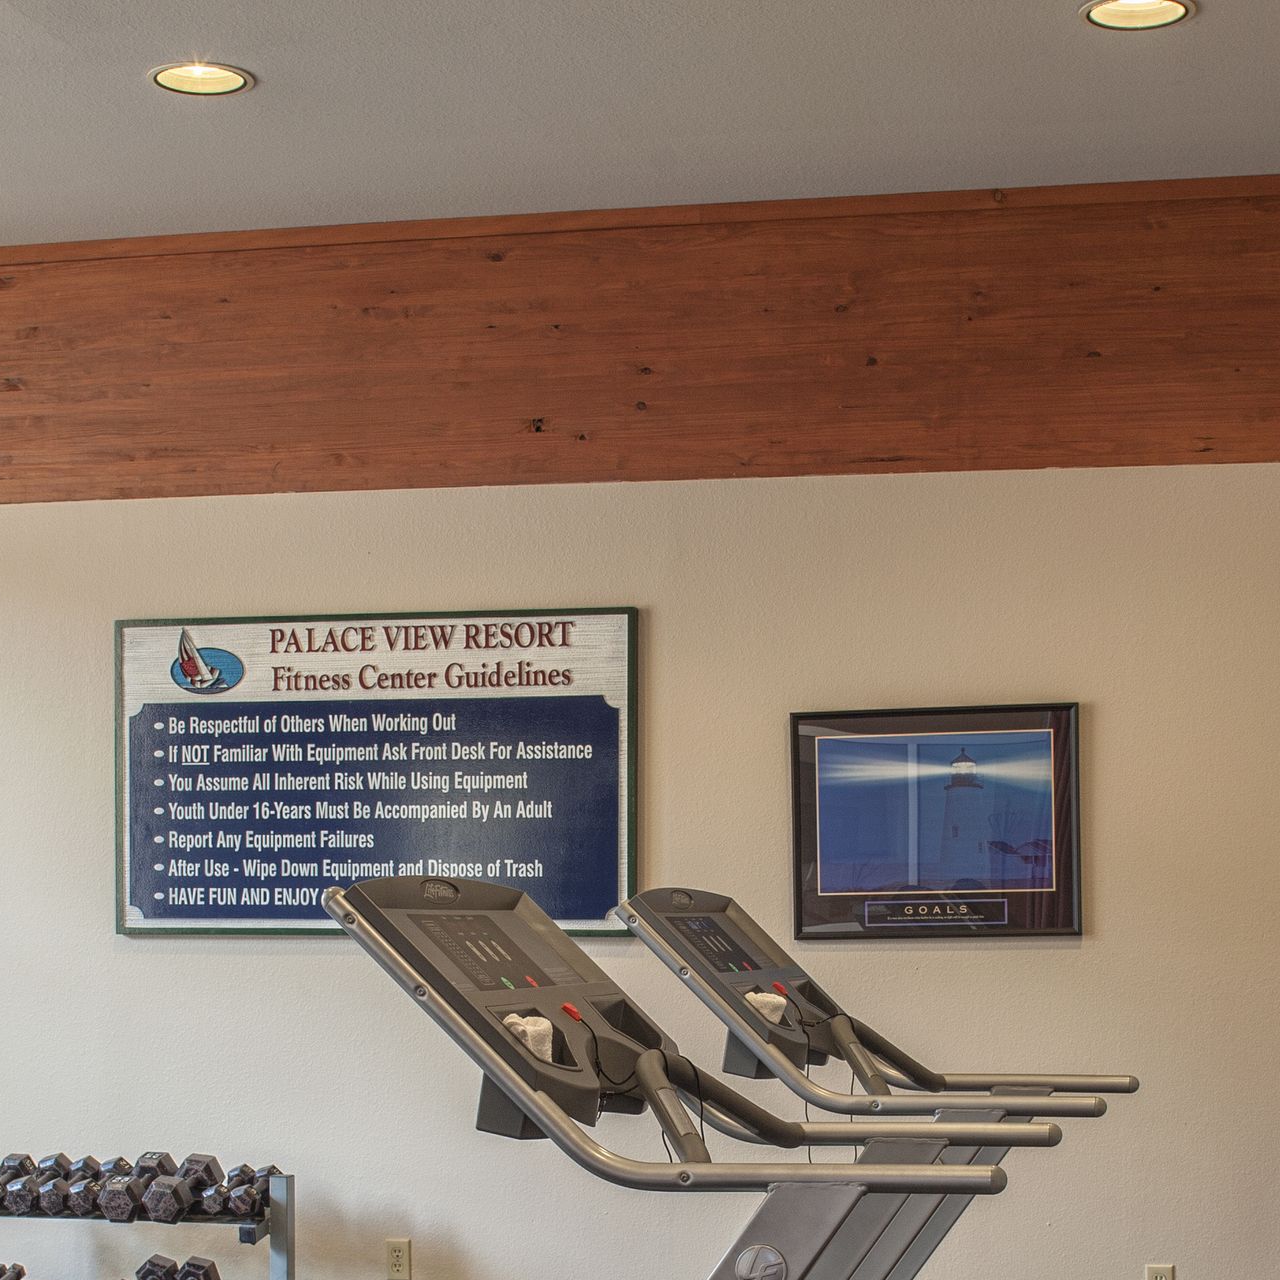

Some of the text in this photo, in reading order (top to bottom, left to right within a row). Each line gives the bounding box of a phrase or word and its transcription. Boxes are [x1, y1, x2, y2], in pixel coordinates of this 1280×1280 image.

[270, 621, 575, 653] PALACE VIEW RESORT
[271, 660, 573, 692] Fitness Center Guidelines
[169, 713, 456, 737] Be Respectful of Others When Working Out
[169, 741, 593, 765] If NOT Familiar With Equipment Ask Front Desk For Assistance
[168, 771, 528, 793] You Assume All Inherent Risk While Using Equipment
[168, 800, 553, 822] Youth Under 16-Years Must Be Accompanied By An Adult
[169, 830, 374, 851] Report Any Equipment Failures
[168, 859, 201, 877] After
[204, 859, 229, 877] Use
[243, 859, 277, 880] Wipe
[281, 859, 318, 877] Down
[322, 859, 394, 880] Equipment
[398, 859, 423, 877] and
[428, 859, 483, 878] Dispose
[487, 859, 501, 877] of
[504, 859, 543, 878] Trash
[169, 888, 319, 906] HAVE FUN AND ENJOY
[904, 905, 968, 915] GOALS
